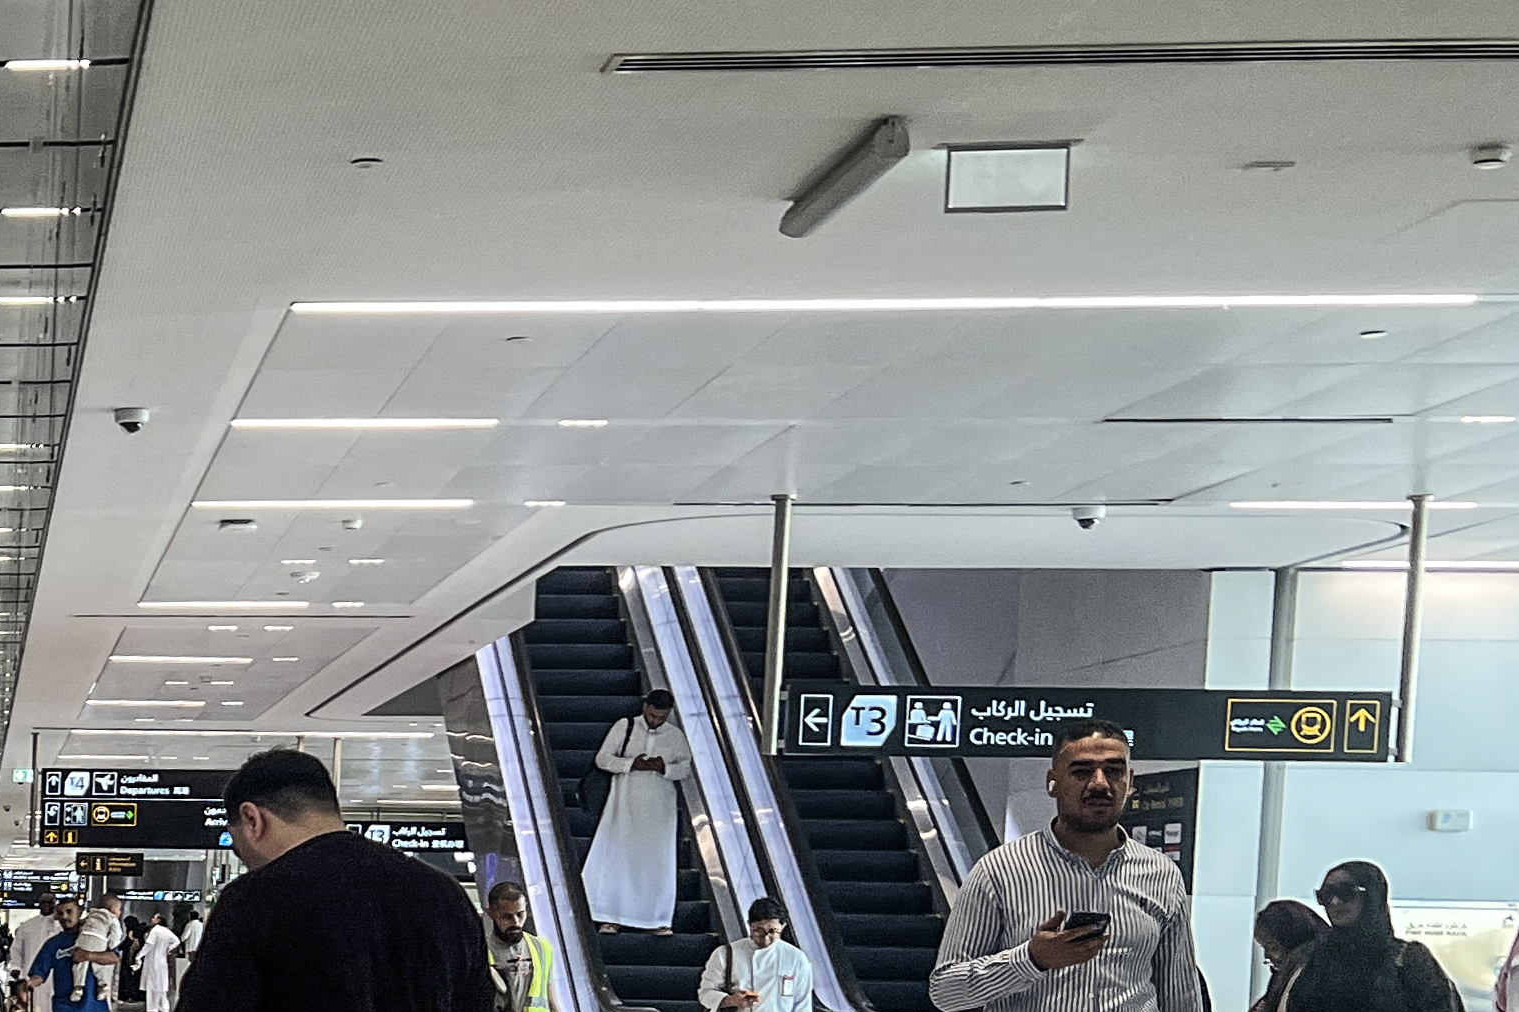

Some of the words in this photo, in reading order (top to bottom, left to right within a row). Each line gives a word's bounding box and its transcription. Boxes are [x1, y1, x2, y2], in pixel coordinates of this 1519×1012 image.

[970, 699, 1026, 721] الركاب
[1029, 699, 1095, 722] تسجيل
[851, 706, 887, 737] T3
[969, 728, 1054, 747] Check-in
[69, 776, 85, 790] T4
[119, 786, 171, 796] Departures
